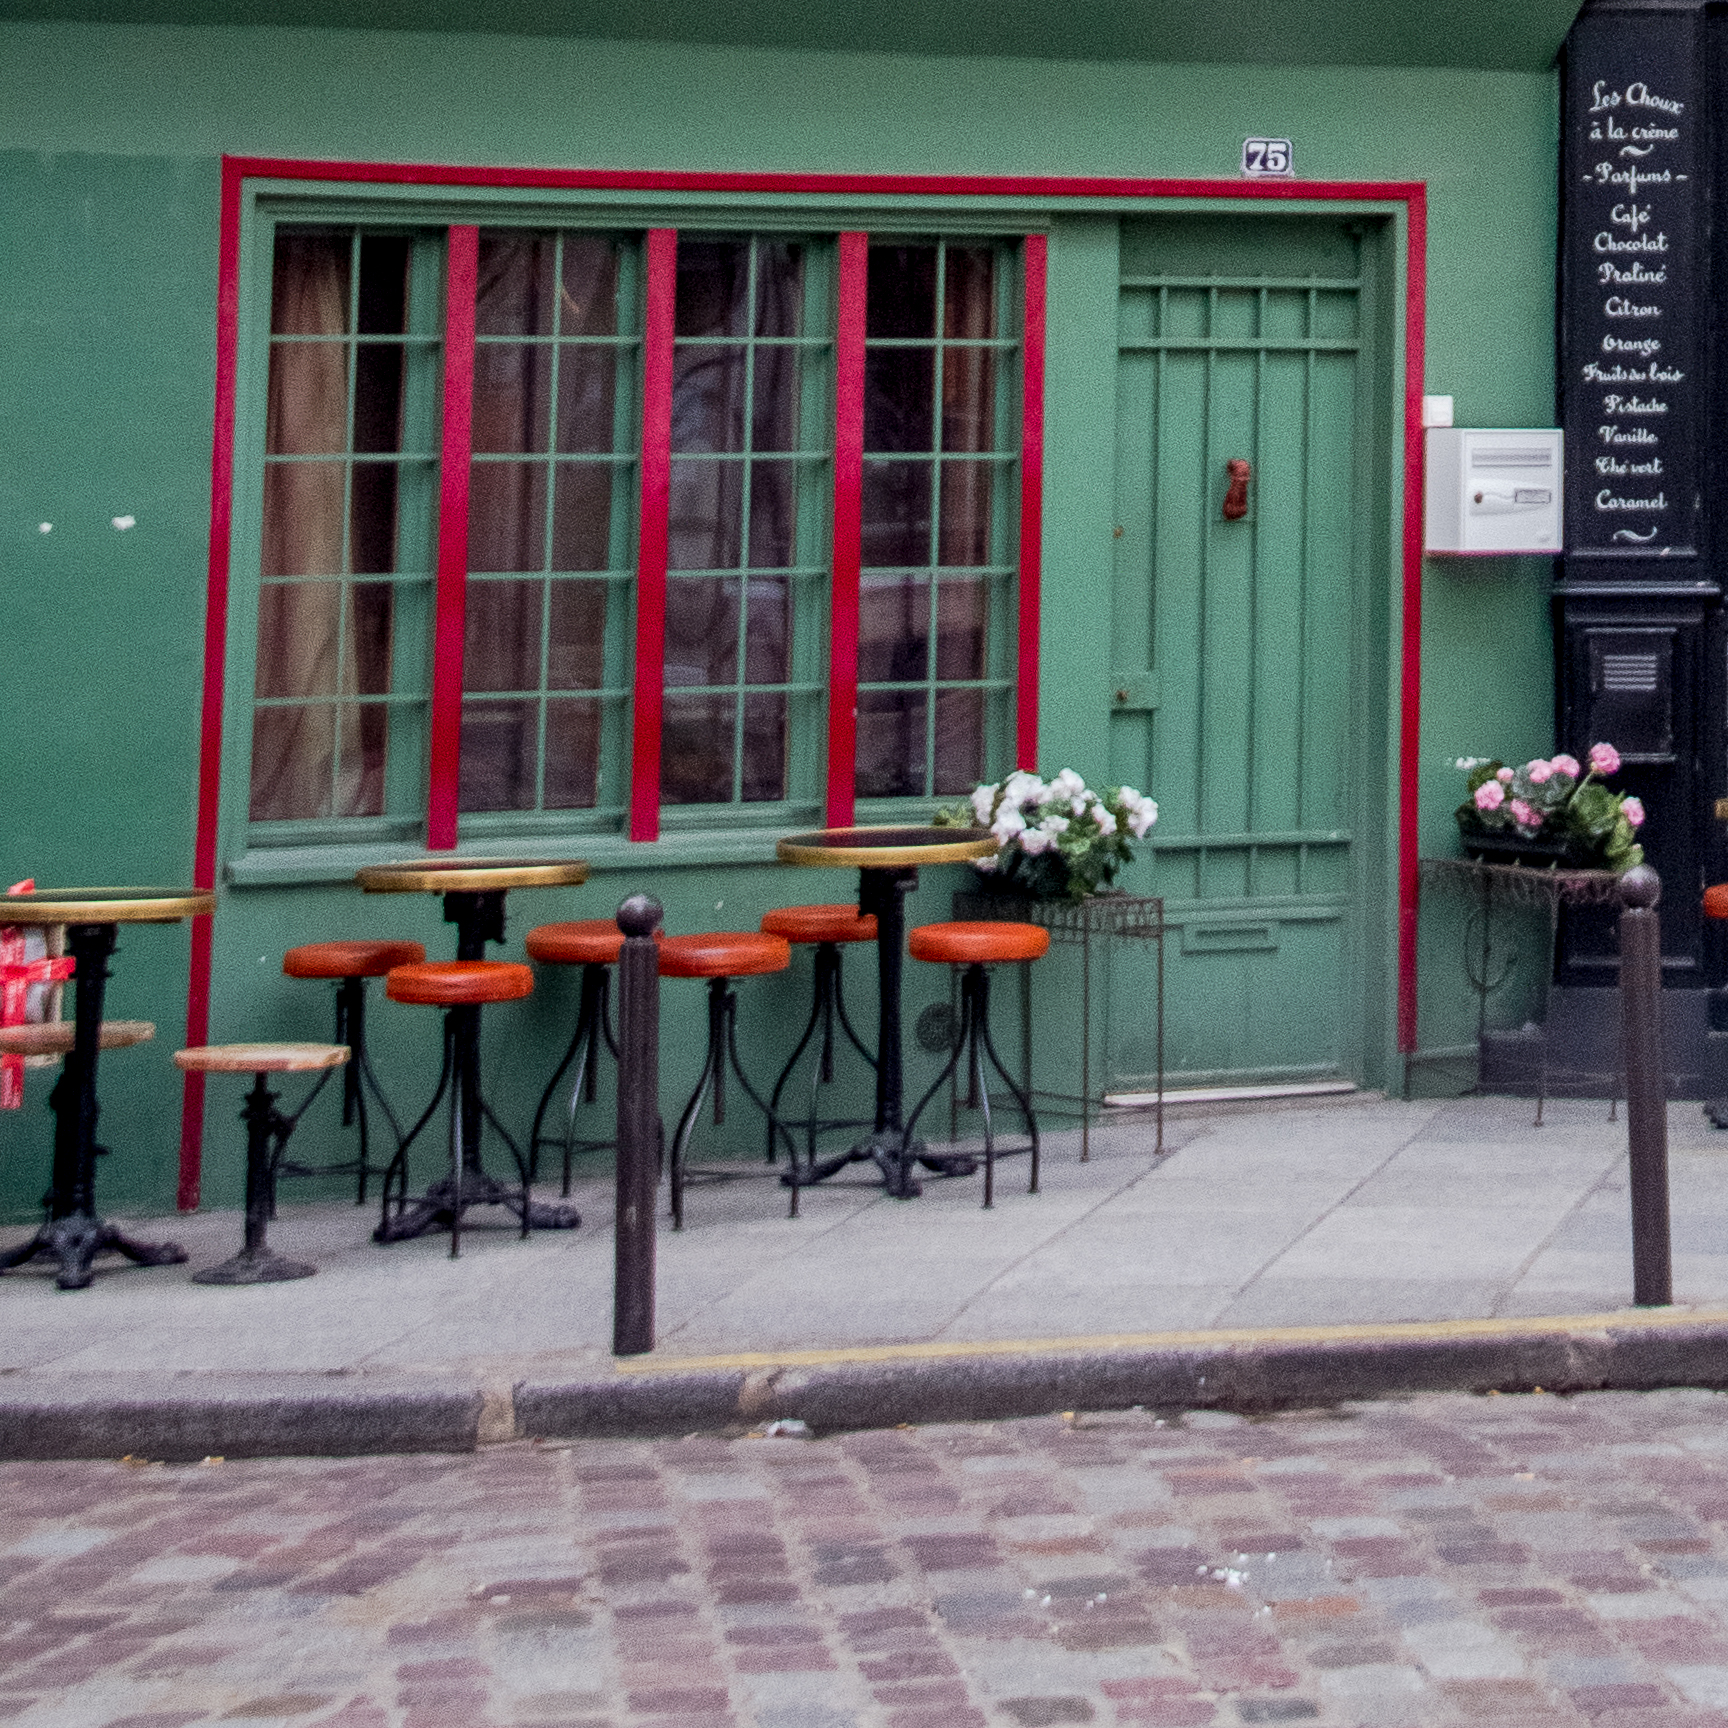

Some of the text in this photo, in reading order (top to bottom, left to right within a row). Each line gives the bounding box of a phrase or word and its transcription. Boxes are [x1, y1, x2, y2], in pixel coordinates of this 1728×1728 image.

[1589, 80, 1684, 115] Les Choux
[1608, 116, 1628, 140] la
[1631, 122, 1679, 140] crème
[1247, 142, 1287, 171] 75
[1595, 161, 1672, 194] Parfums
[1610, 203, 1652, 233] Café
[1593, 231, 1669, 252] Chocolat
[1598, 261, 1668, 284] Praliné
[1604, 295, 1663, 317] Citron
[1604, 393, 1669, 415] Pistache
[1599, 425, 1659, 444] Vanille
[1595, 488, 1669, 511] Caramel
